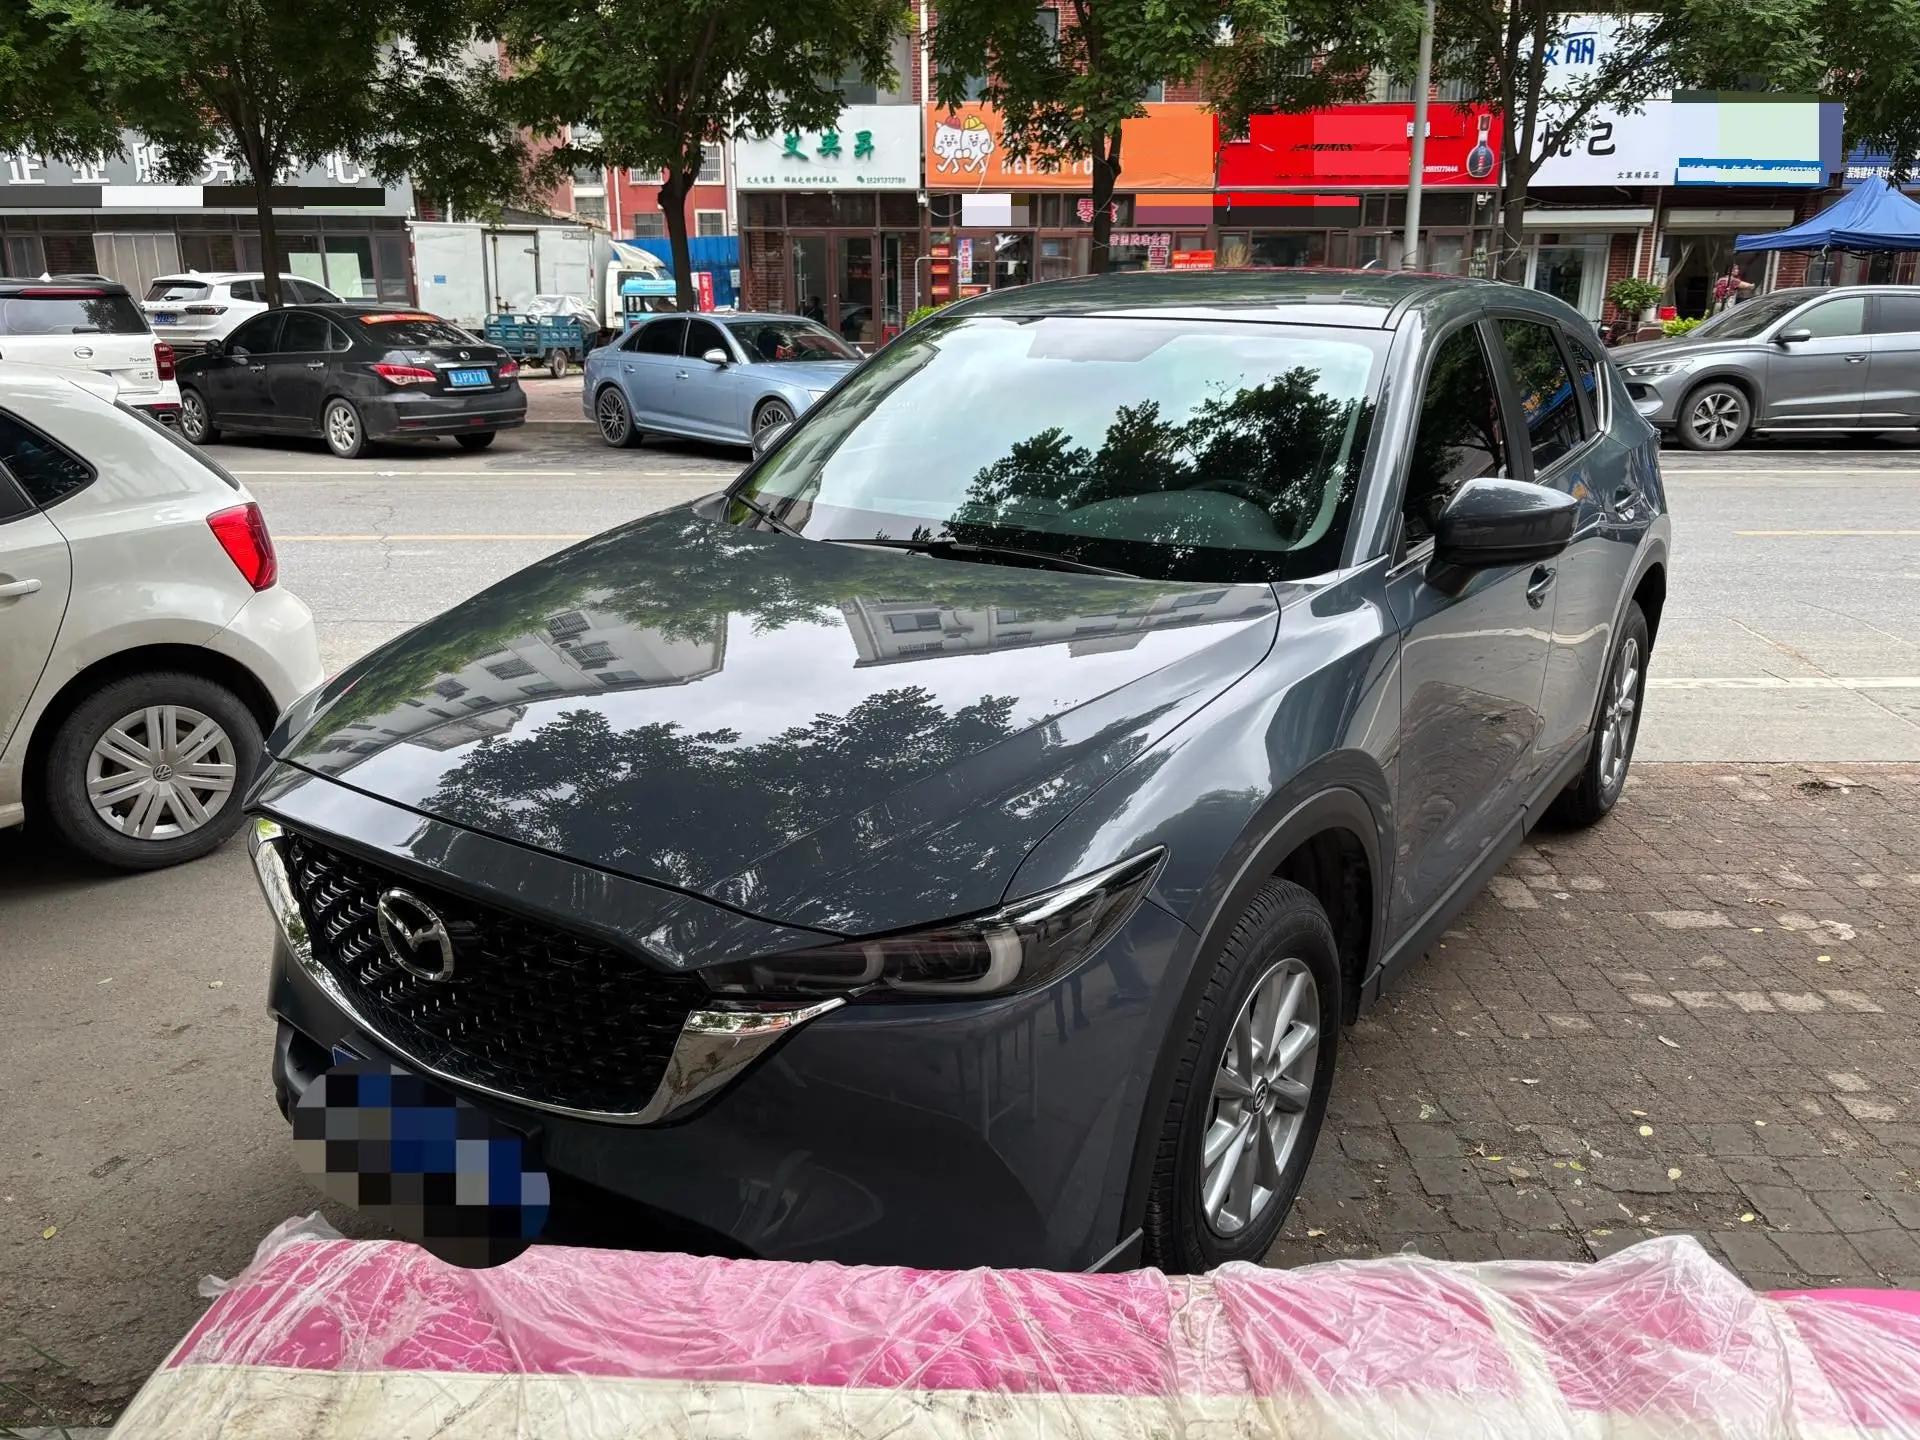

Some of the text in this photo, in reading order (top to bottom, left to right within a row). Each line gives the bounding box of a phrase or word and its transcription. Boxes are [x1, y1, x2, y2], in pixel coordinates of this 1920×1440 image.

[2, 142, 367, 185] 企业服务心
